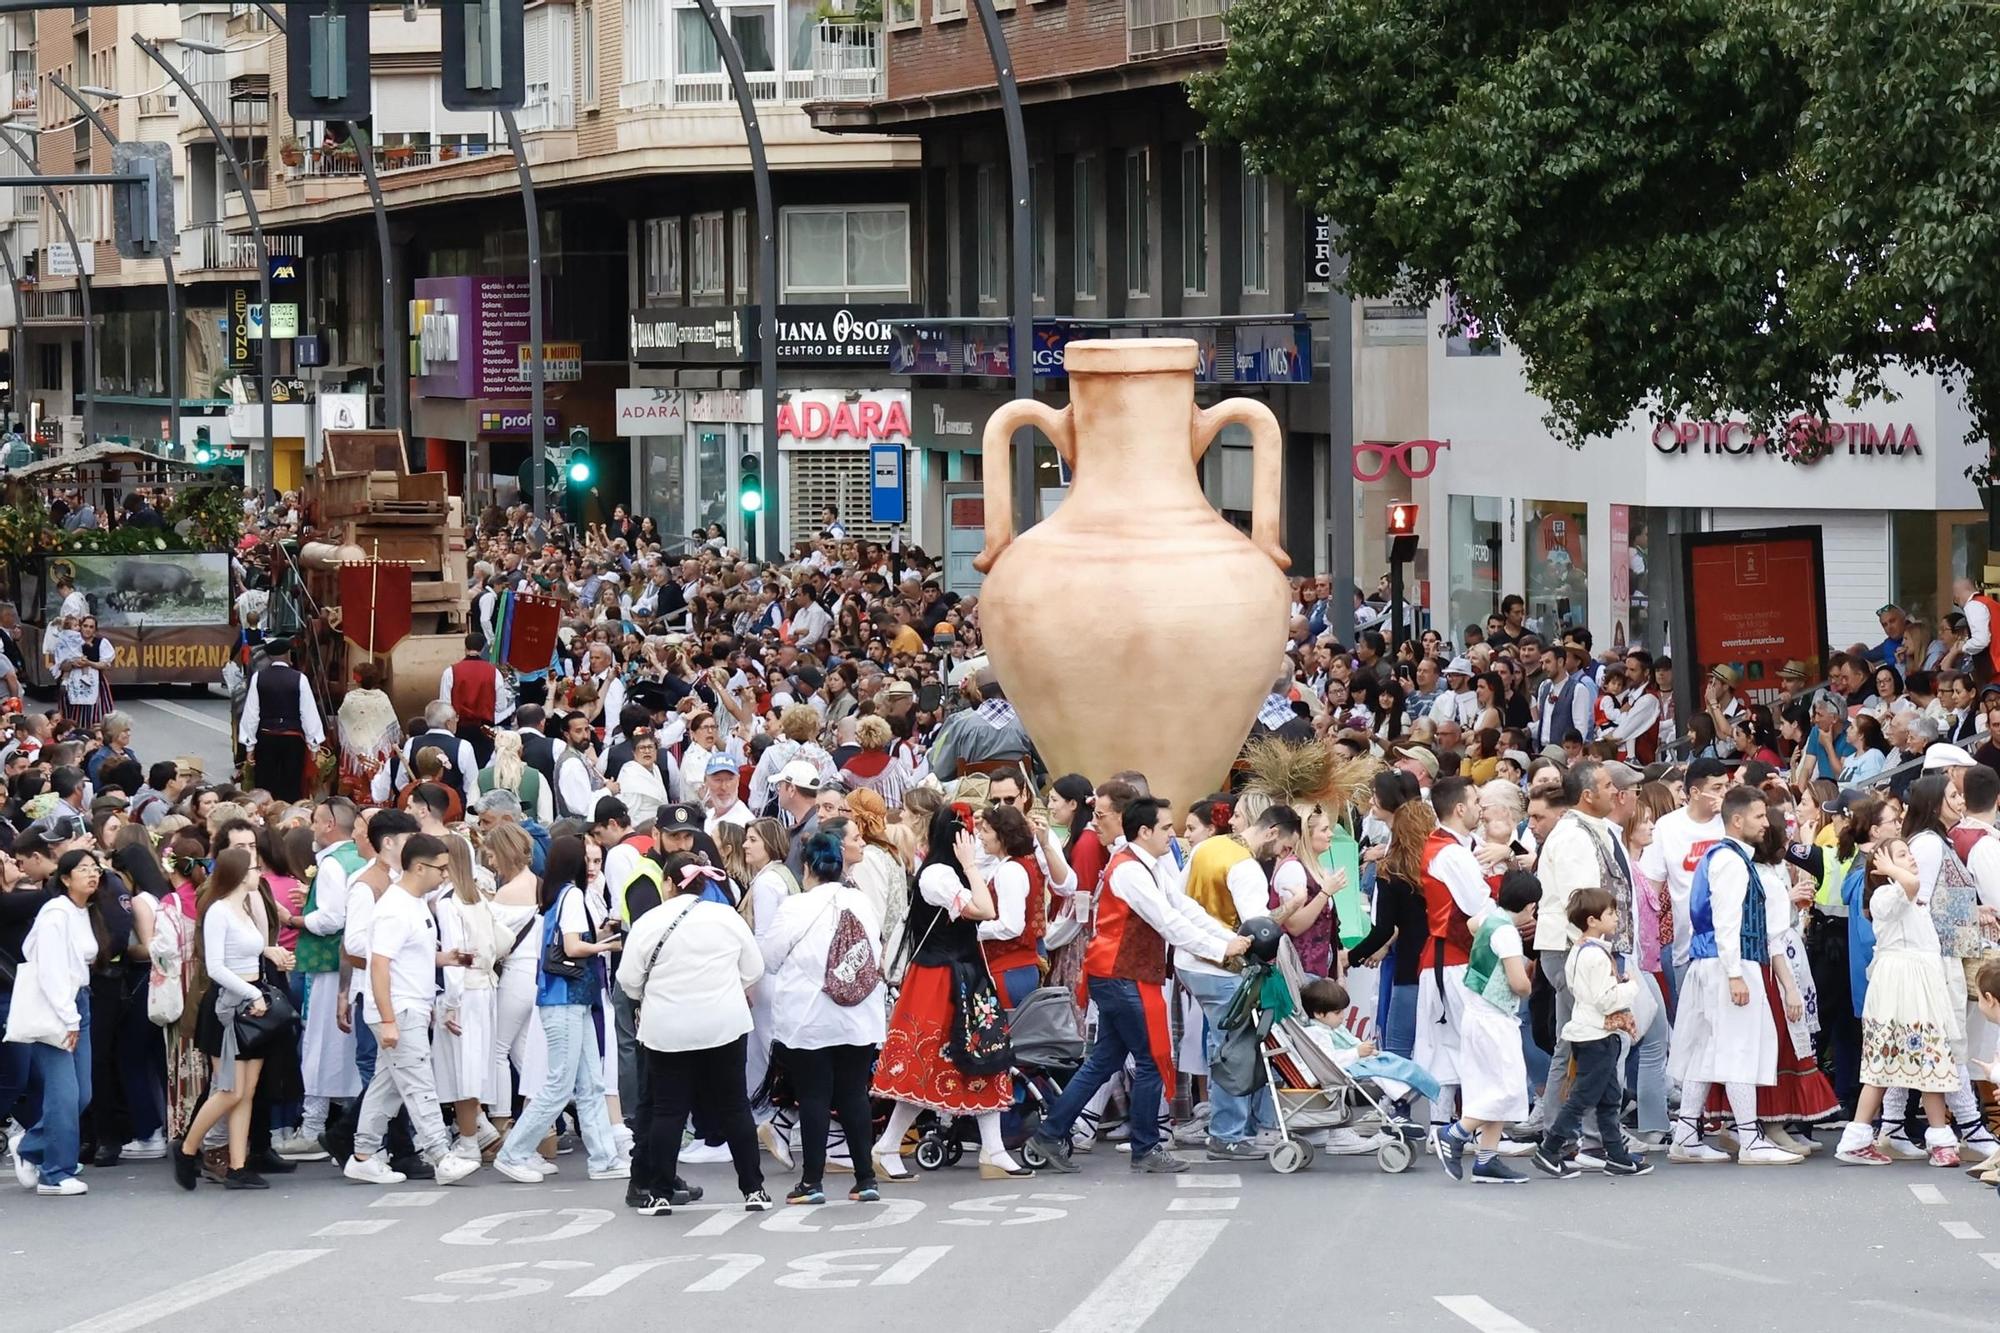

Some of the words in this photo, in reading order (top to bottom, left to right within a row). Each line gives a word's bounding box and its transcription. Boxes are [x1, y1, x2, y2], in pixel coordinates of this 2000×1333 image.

[272, 266, 295, 278] AXA
[235, 289, 248, 360] BEYOND
[833, 309, 892, 343] OSOR
[777, 345, 823, 356] CENTRO
[827, 345, 842, 356] DE
[847, 345, 890, 356] BELLEZ
[1268, 347, 1288, 376] MGS
[622, 406, 680, 418] ADARA
[777, 400, 912, 440] ADARA
[1721, 635, 1785, 648] eventos.murcia.es
[143, 645, 231, 669] HUERTANA
